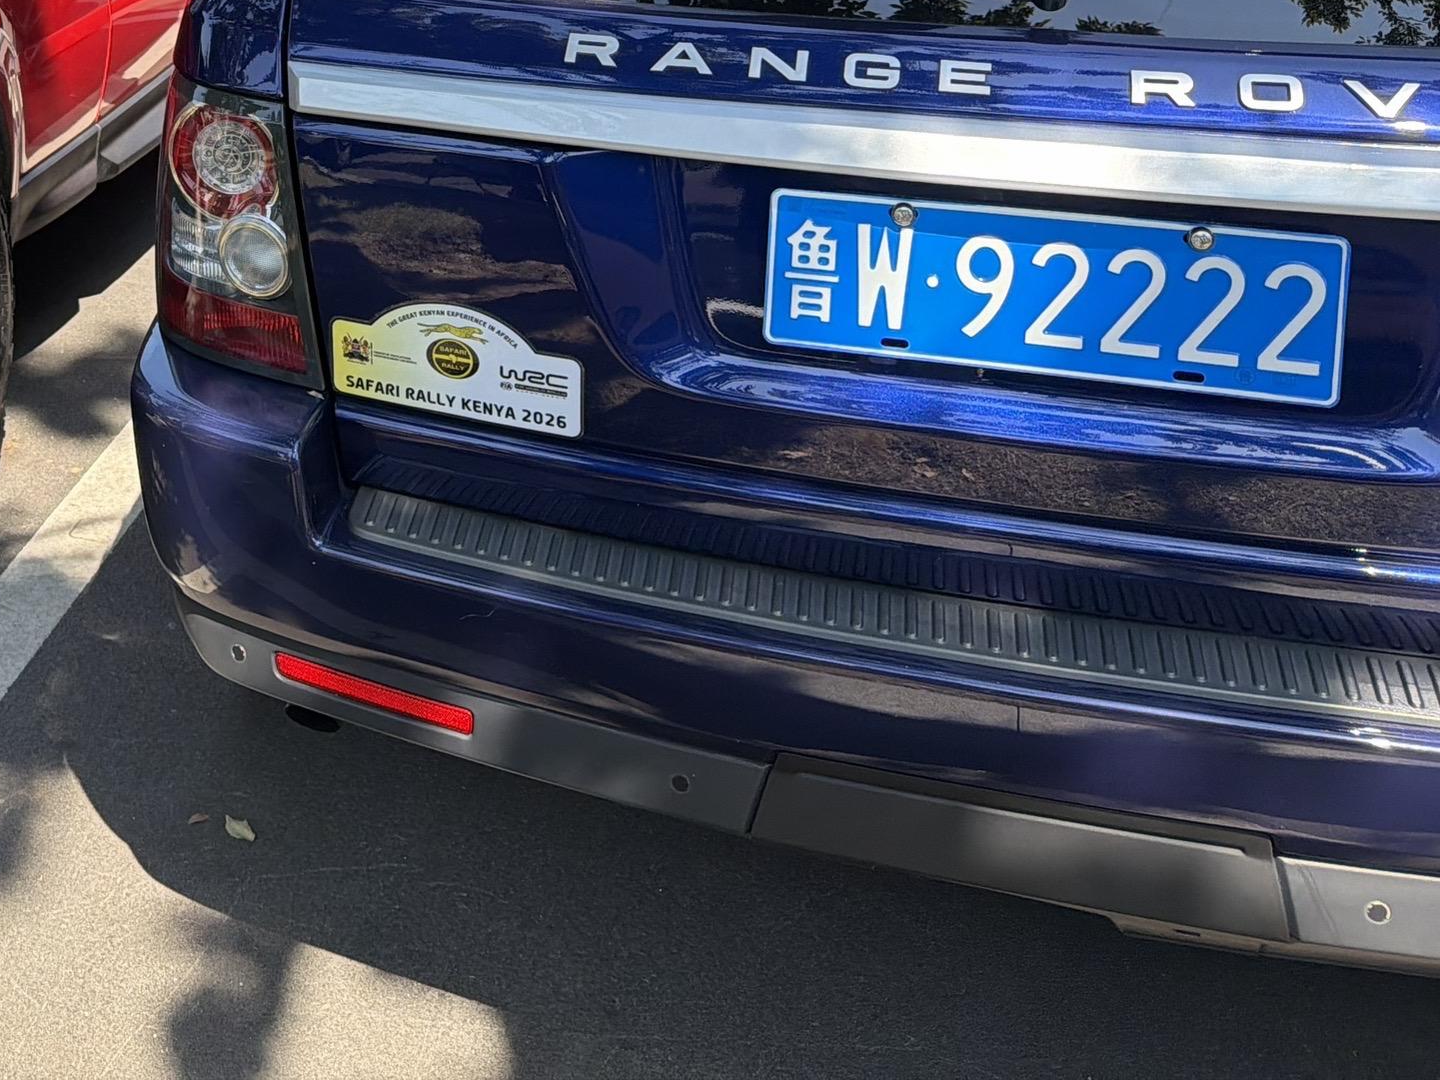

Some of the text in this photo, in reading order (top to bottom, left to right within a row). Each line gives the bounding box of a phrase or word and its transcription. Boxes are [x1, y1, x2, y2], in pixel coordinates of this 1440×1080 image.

[563, 33, 1421, 120] RANGE ROV
[386, 318, 398, 329] THE
[398, 310, 418, 322] GREAT
[446, 310, 487, 328] EXPERIENCE
[488, 324, 496, 332] IN
[495, 329, 518, 349] AFRICA
[439, 345, 467, 356] SAFARI
[441, 362, 465, 371] RALLY
[500, 365, 568, 389] WRC
[346, 375, 567, 429] SAFARI RALLY KENYA 2026
